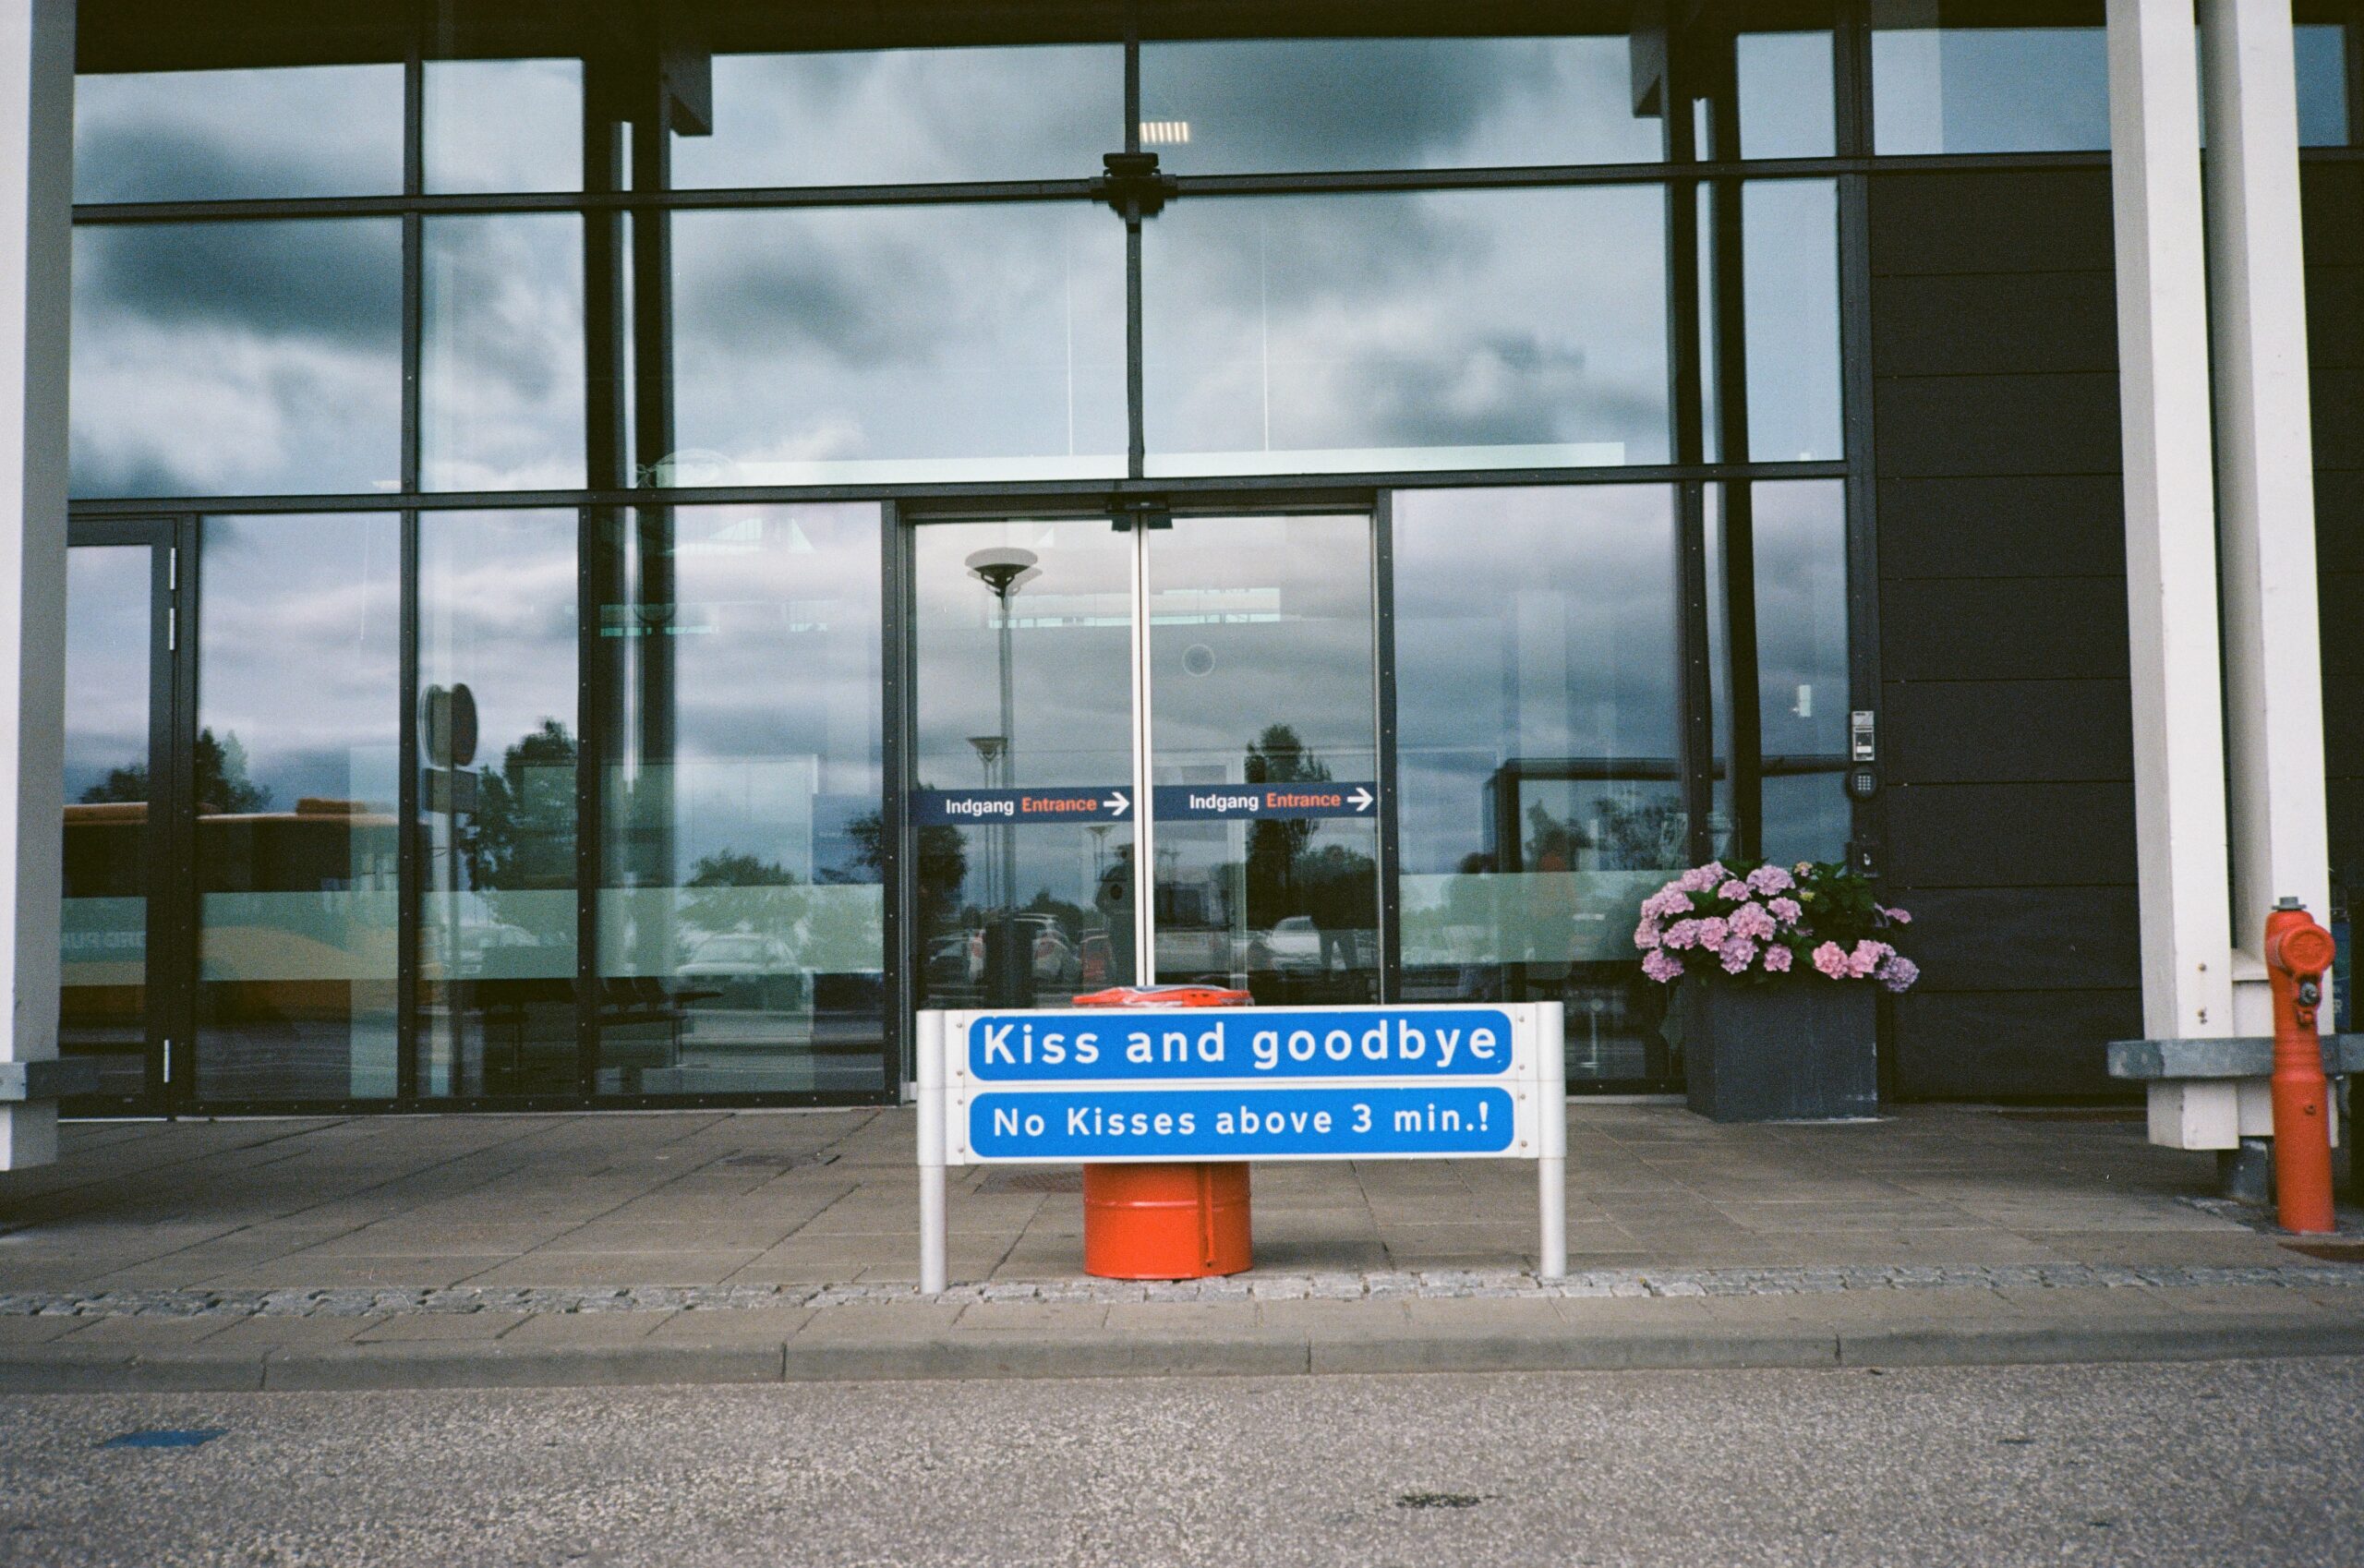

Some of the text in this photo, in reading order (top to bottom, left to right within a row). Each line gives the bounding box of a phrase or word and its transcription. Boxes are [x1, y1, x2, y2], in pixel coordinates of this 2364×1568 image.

[946, 797, 1098, 816] Indgang Entrance
[1189, 791, 1341, 812] Indgang Entrance
[983, 1019, 1497, 1069] Kiss and goodbye
[994, 1101, 1490, 1137] No Kisses above 3 min.!
